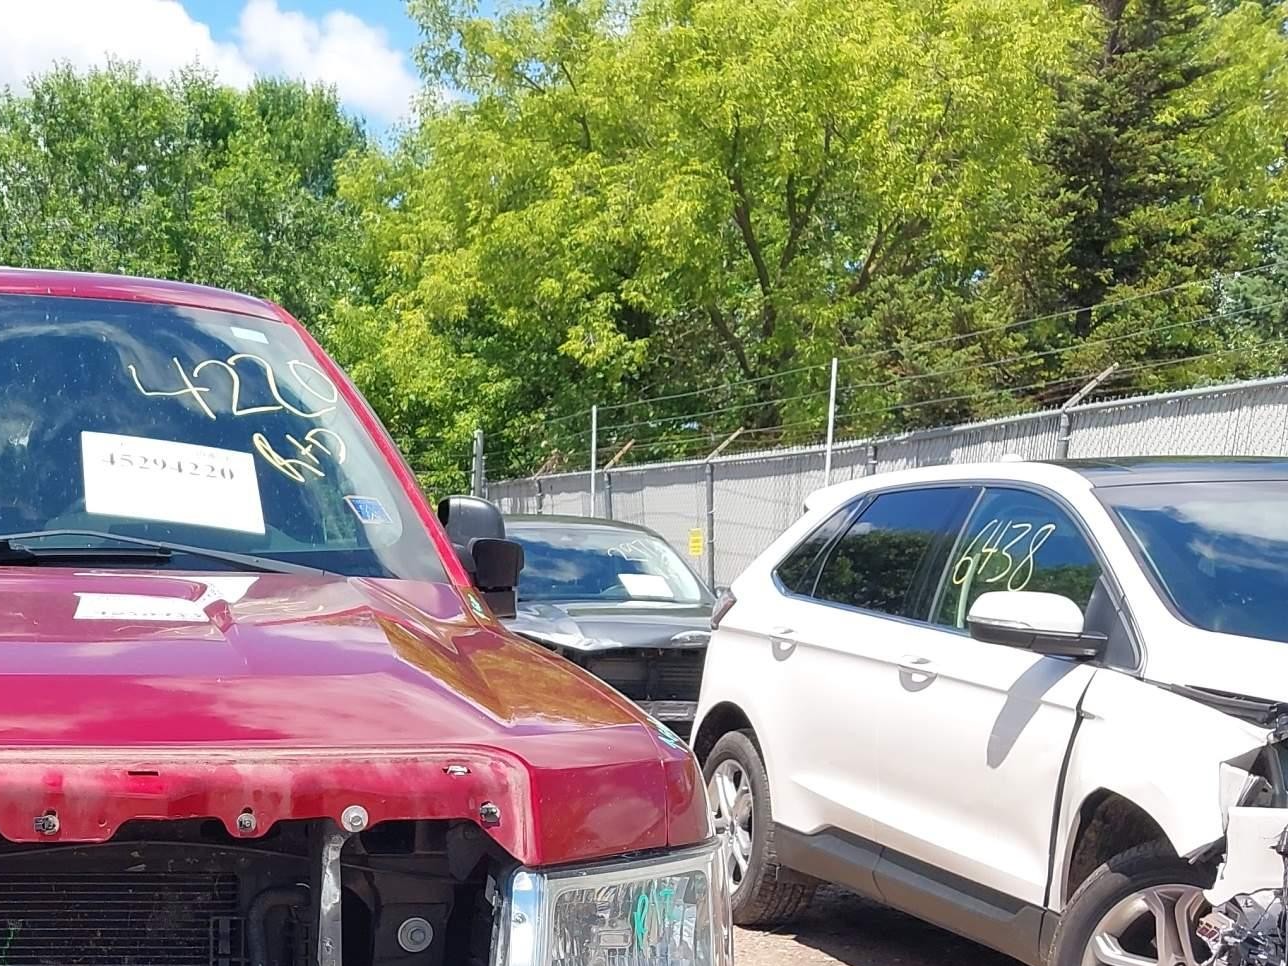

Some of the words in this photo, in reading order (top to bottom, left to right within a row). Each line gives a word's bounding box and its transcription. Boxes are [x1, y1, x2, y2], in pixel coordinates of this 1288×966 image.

[127, 352, 338, 421] 4220
[101, 451, 236, 481] 45294220
[952, 518, 1057, 592] 6438
